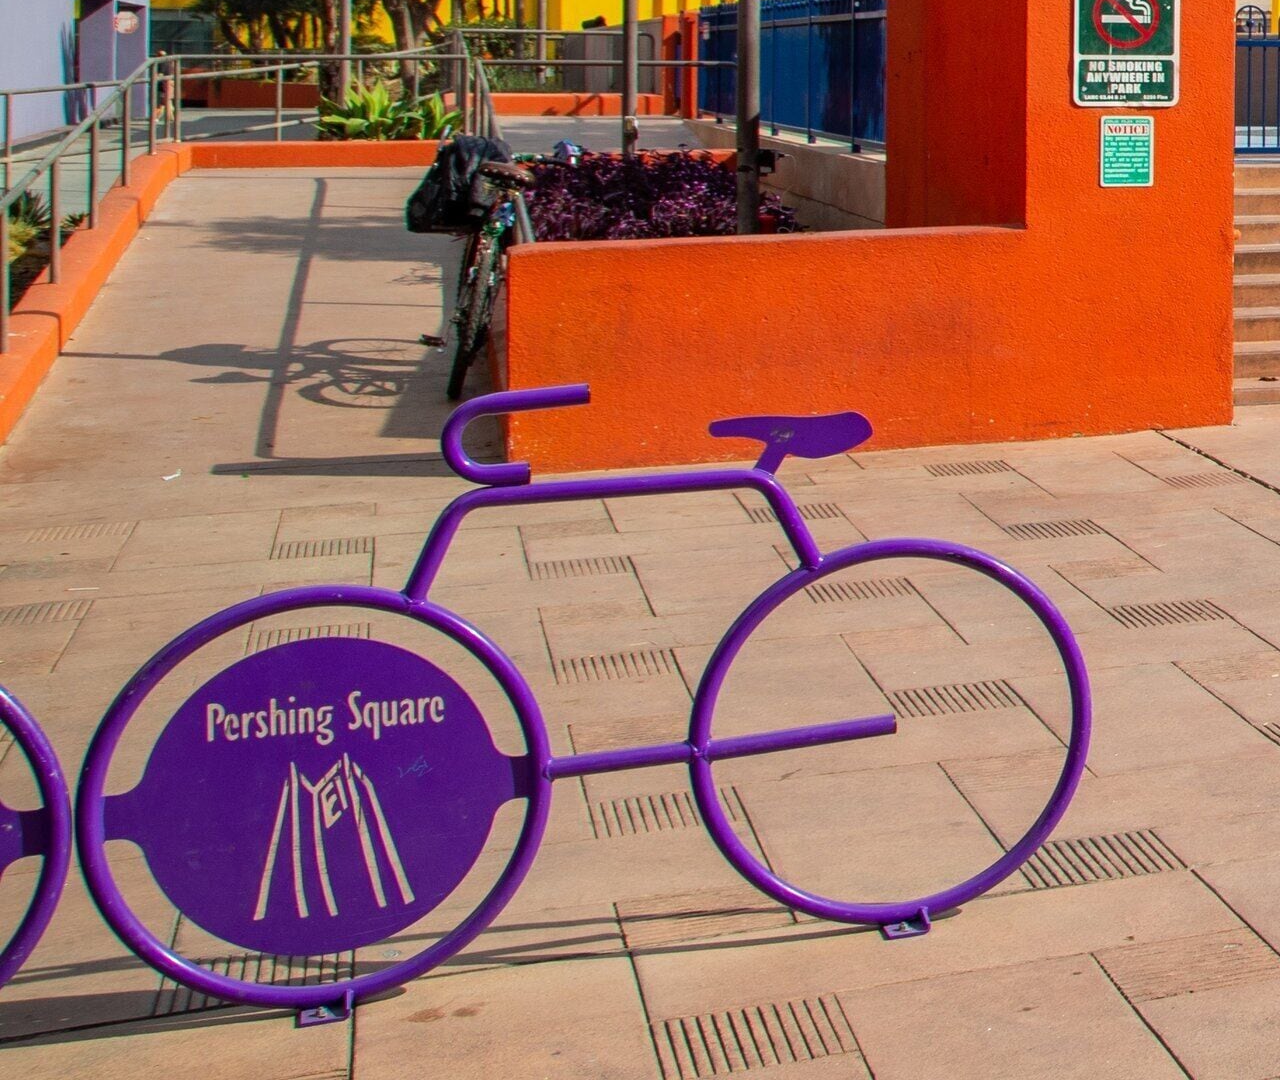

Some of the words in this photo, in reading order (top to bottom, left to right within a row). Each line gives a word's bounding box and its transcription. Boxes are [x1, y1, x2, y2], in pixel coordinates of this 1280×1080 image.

[1089, 61, 1106, 72] NO
[1108, 61, 1163, 72] SMOKING
[1086, 72, 1150, 83] ANYWHERE
[1152, 72, 1165, 83] IN
[1110, 83, 1142, 94] PARK
[1106, 125, 1149, 135] NOTICE
[206, 696, 335, 746] Pershing
[347, 690, 446, 741] Square
